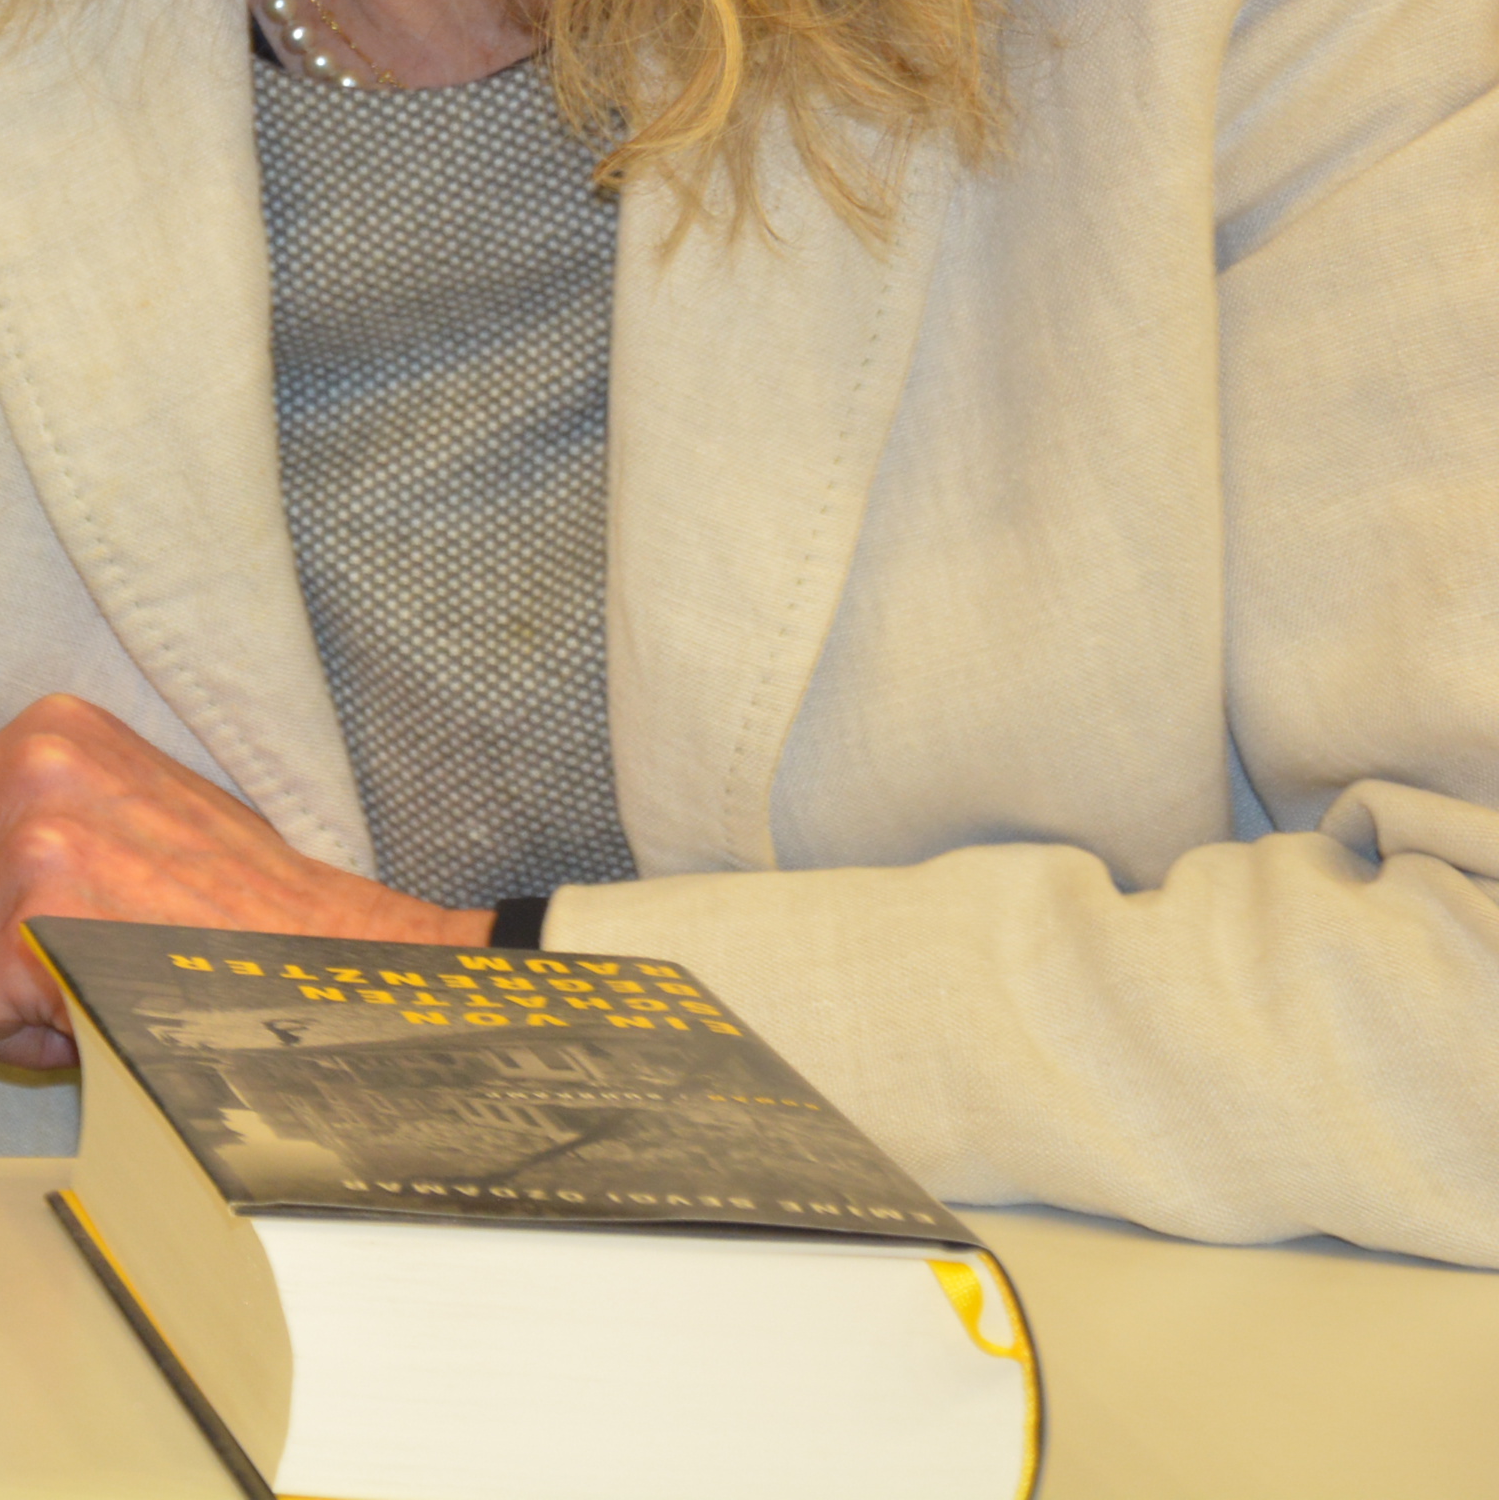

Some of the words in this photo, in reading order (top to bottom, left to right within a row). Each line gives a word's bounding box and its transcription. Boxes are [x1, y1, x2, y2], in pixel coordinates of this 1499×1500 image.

[166, 953, 702, 999] BEGRENZTER
[455, 953, 684, 980] RAUM
[297, 984, 724, 1017] SCHATTEN
[401, 1010, 572, 1029] VON
[604, 1014, 744, 1038] EIN
[778, 1200, 937, 1226] EMINE
